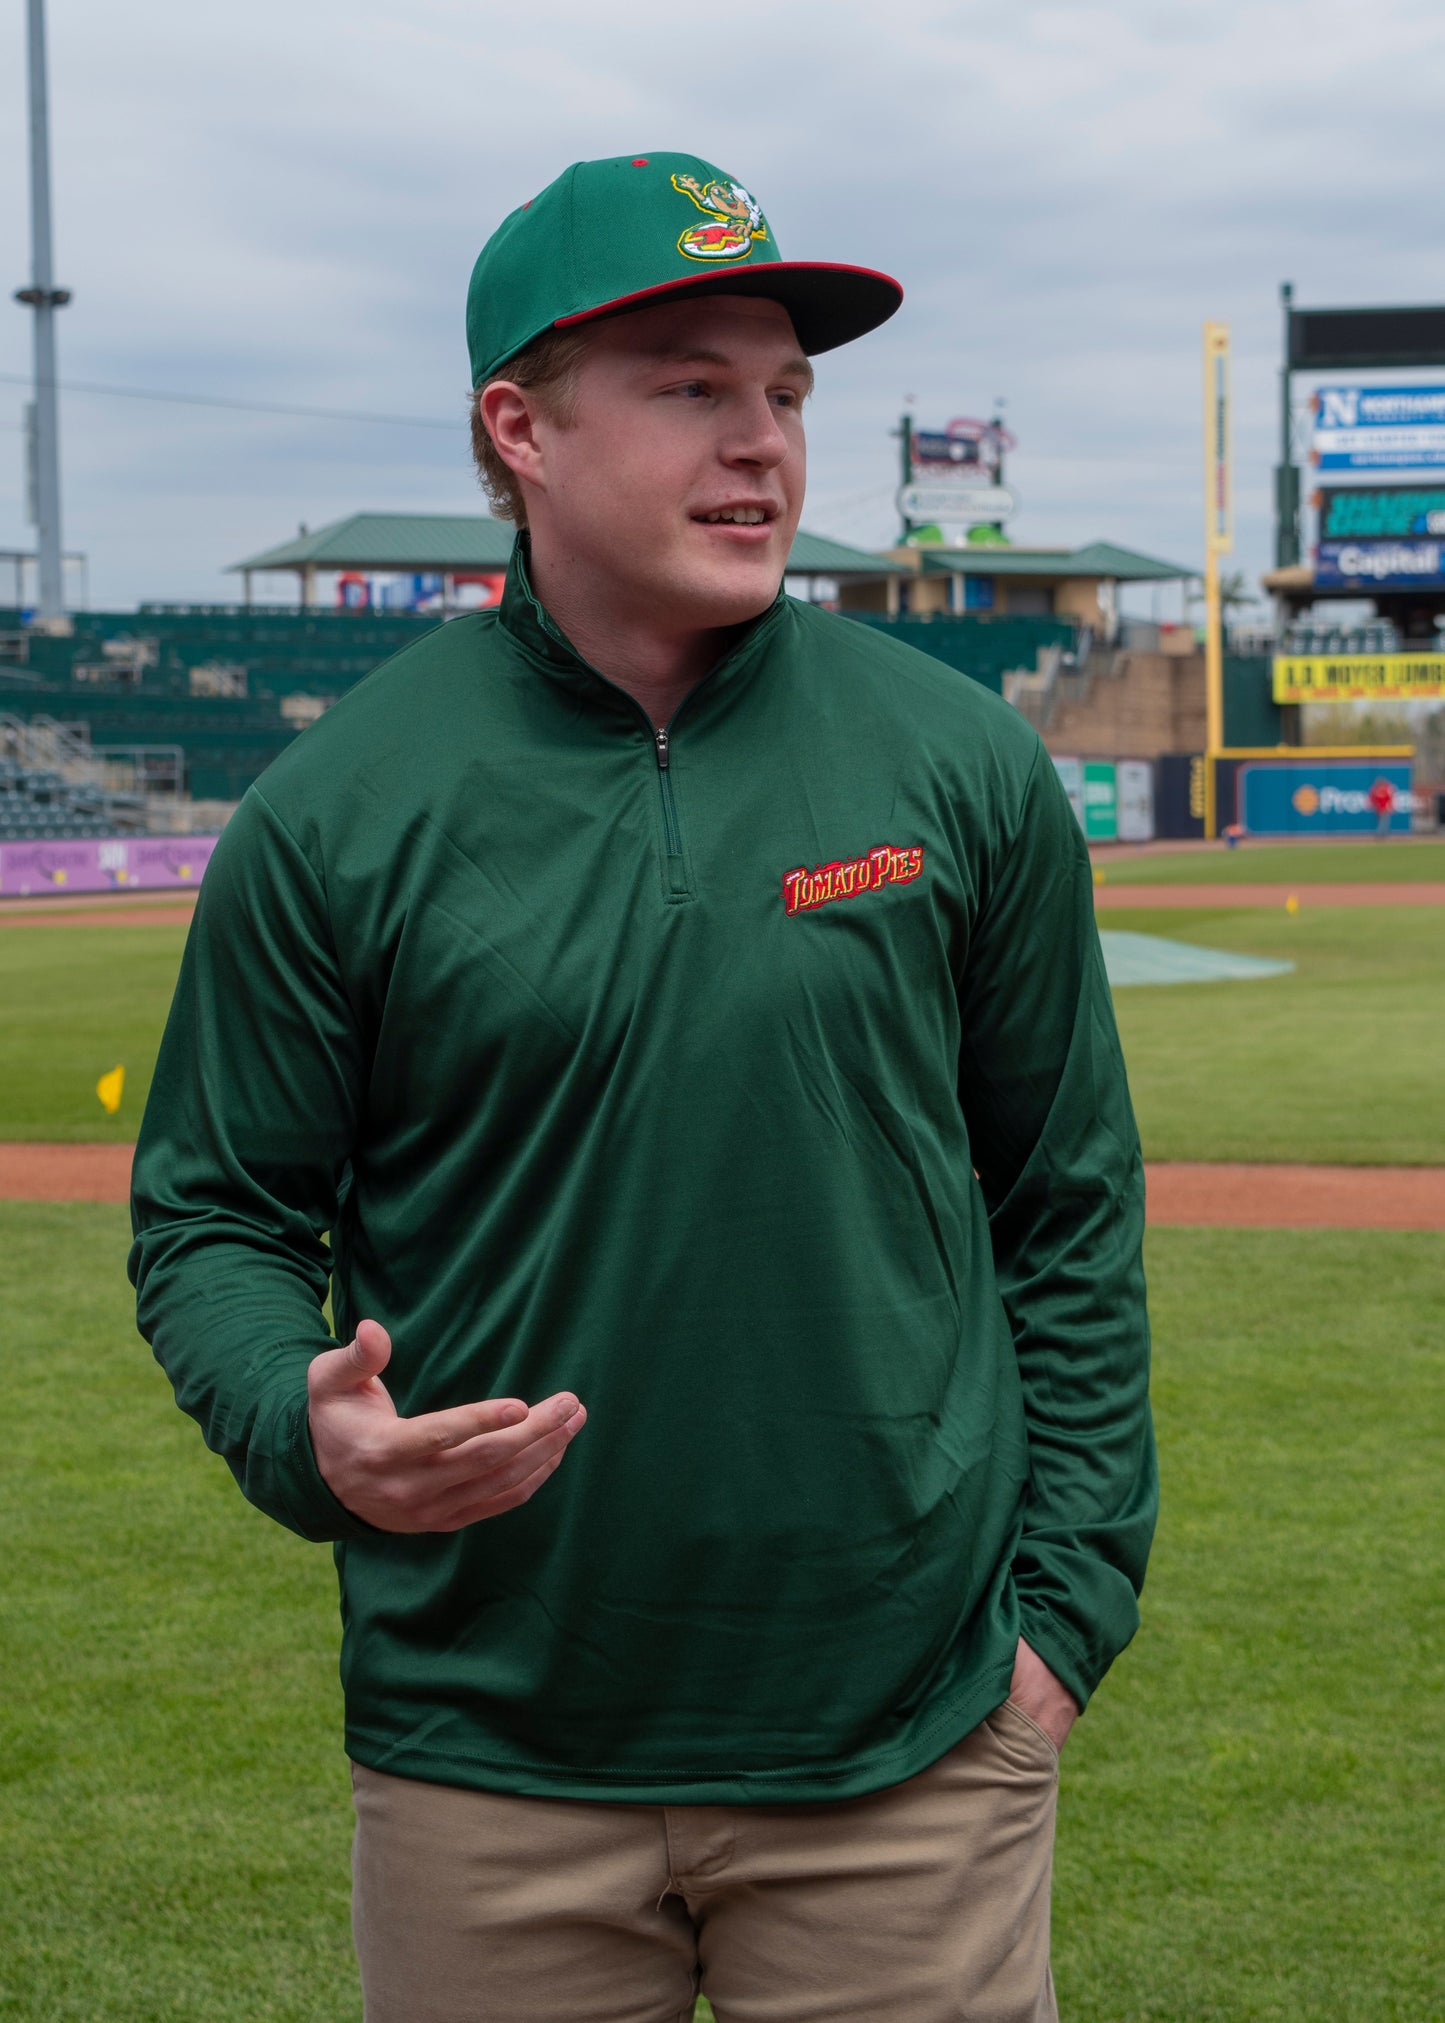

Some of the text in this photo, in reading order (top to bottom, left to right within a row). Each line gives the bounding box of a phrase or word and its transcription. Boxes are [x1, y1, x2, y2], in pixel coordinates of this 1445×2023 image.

[1338, 546, 1439, 580] Capital
[783, 847, 922, 914] TOMATO PIES
